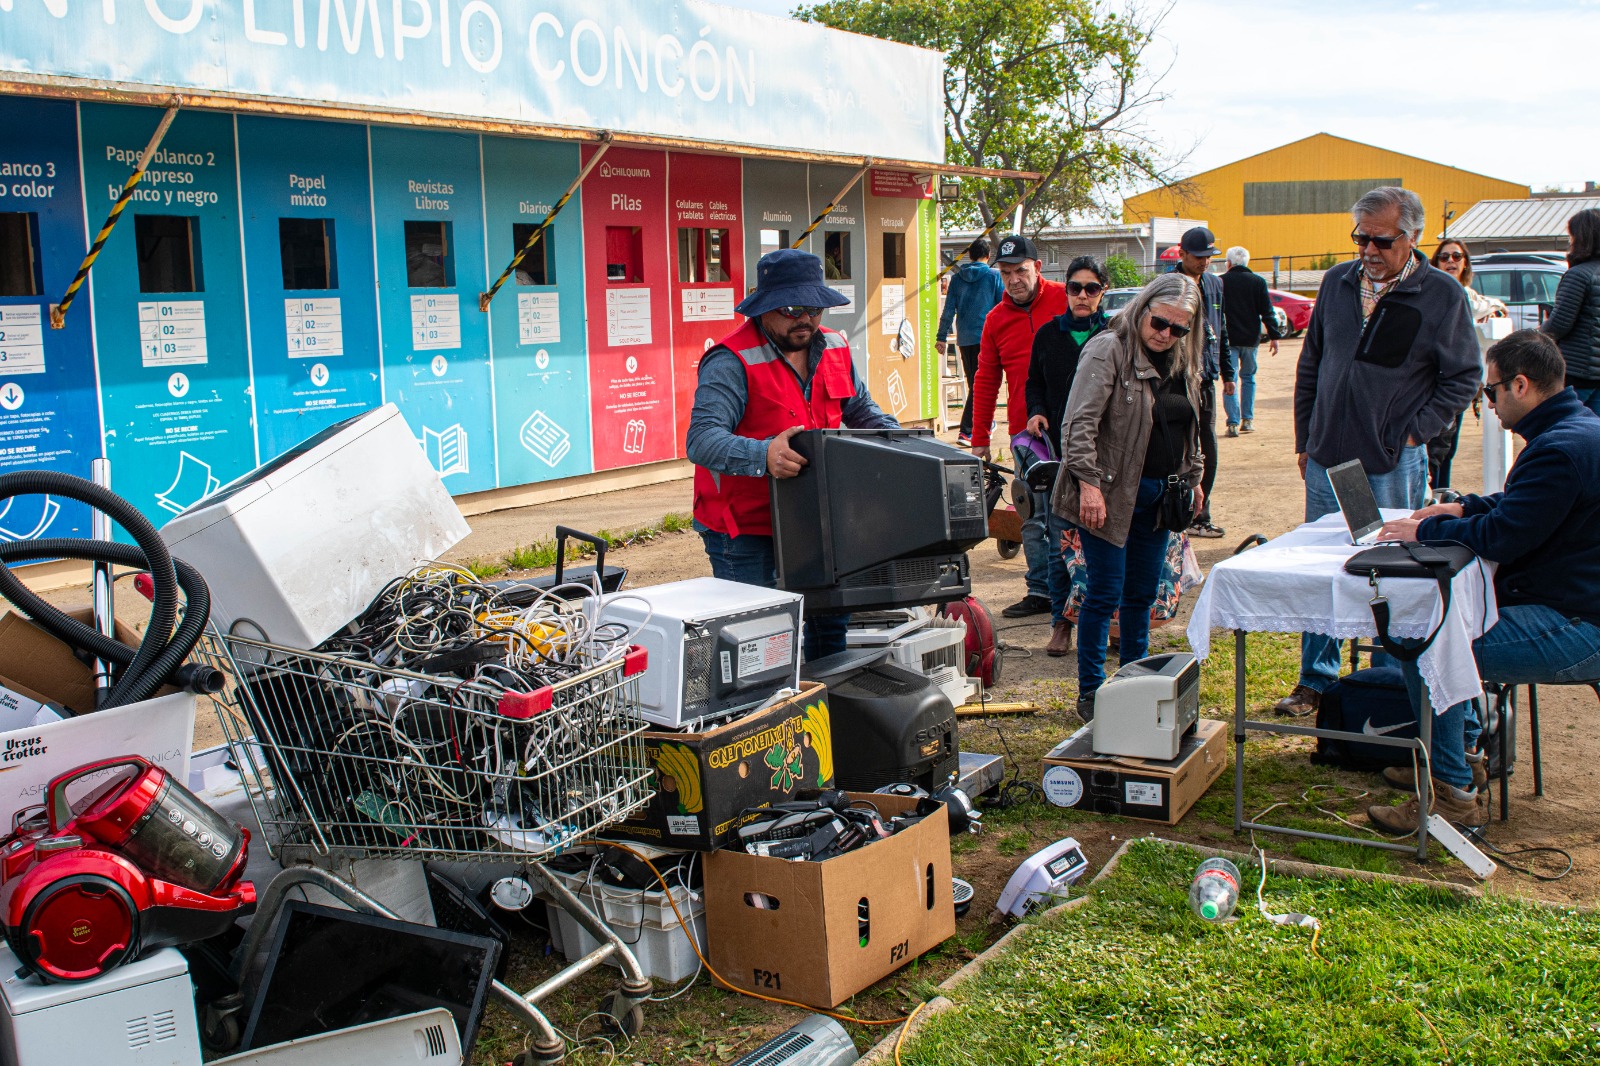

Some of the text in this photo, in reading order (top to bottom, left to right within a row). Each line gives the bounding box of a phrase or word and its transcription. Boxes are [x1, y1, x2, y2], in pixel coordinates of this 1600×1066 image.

[529, 12, 755, 106] CONCÓN
[106, 146, 150, 166] Pape
[206, 152, 216, 166] 2
[0, 162, 56, 178] anco 3
[132, 165, 194, 187] mpreso
[611, 167, 651, 178] CHILQUINTA
[12, 180, 55, 198] color
[289, 174, 326, 190] Papel
[408, 179, 454, 195] Revistas
[108, 184, 218, 207] blnco y negro
[290, 191, 327, 207] mixto
[611, 193, 642, 211] Pilas
[415, 196, 449, 211] Libros
[519, 200, 552, 215] Diarios
[675, 199, 704, 210] Celulares
[708, 201, 728, 210] Cables
[677, 211, 704, 220] y tablets
[762, 211, 792, 223] Aluminio
[825, 214, 856, 225] Conservas
[880, 217, 905, 228] Tetrapak
[923, 208, 931, 292] @ecorutavecinal
[304, 303, 314, 311] 01
[427, 299, 436, 307] 01
[532, 297, 539, 305] 01
[161, 306, 173, 316] 01
[305, 320, 315, 329] 02
[428, 315, 437, 323] 02
[163, 325, 175, 335] 02
[164, 344, 176, 353] 03
[306, 337, 316, 345] 03
[924, 309, 932, 415] www.ecorutavecinal.cl
[792, 715, 803, 734] EL
[915, 718, 953, 743] SONY
[6, 736, 42, 750] Ursus
[2, 745, 48, 762] Trotter
[890, 938, 909, 965] F21
[753, 969, 782, 990] F21
